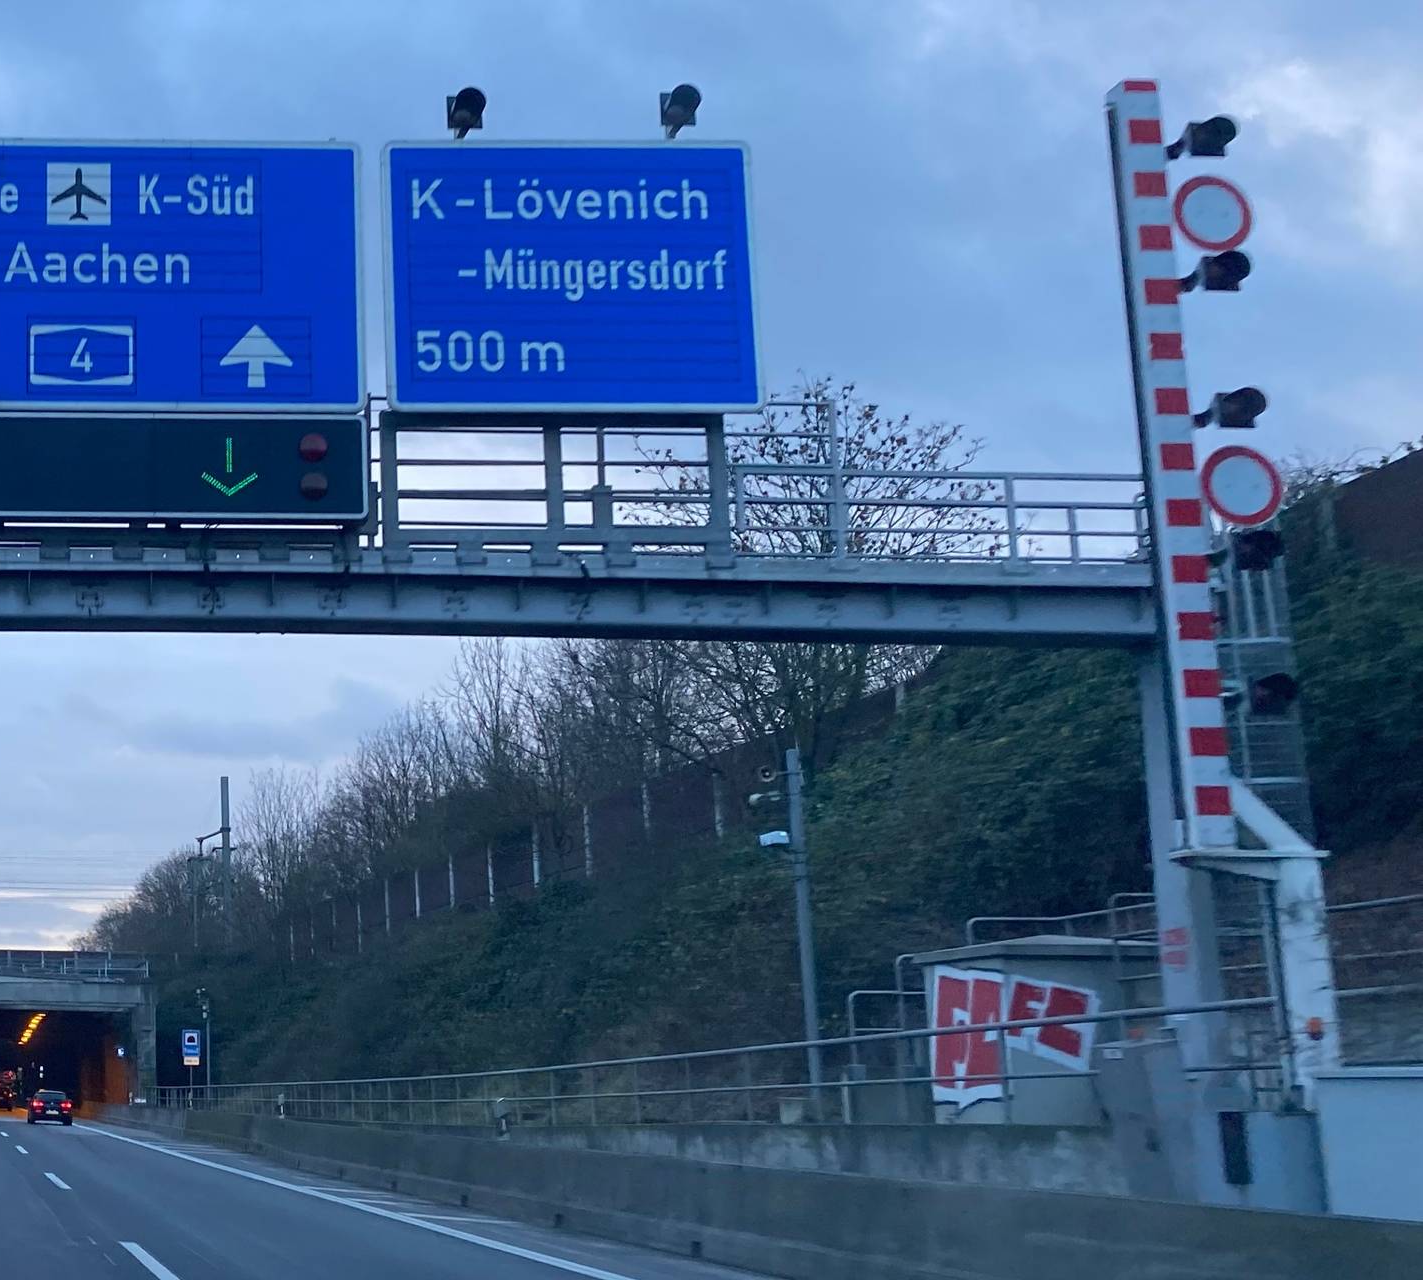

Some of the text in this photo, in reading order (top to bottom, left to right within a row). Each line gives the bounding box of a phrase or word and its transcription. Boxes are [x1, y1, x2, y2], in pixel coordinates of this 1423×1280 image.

[139, 174, 254, 215] K-Süd
[4, 241, 190, 284] Aachen
[458, 248, 727, 302] -Müngersdorf
[70, 337, 93, 373] 4
[416, 330, 566, 372] 500 m
